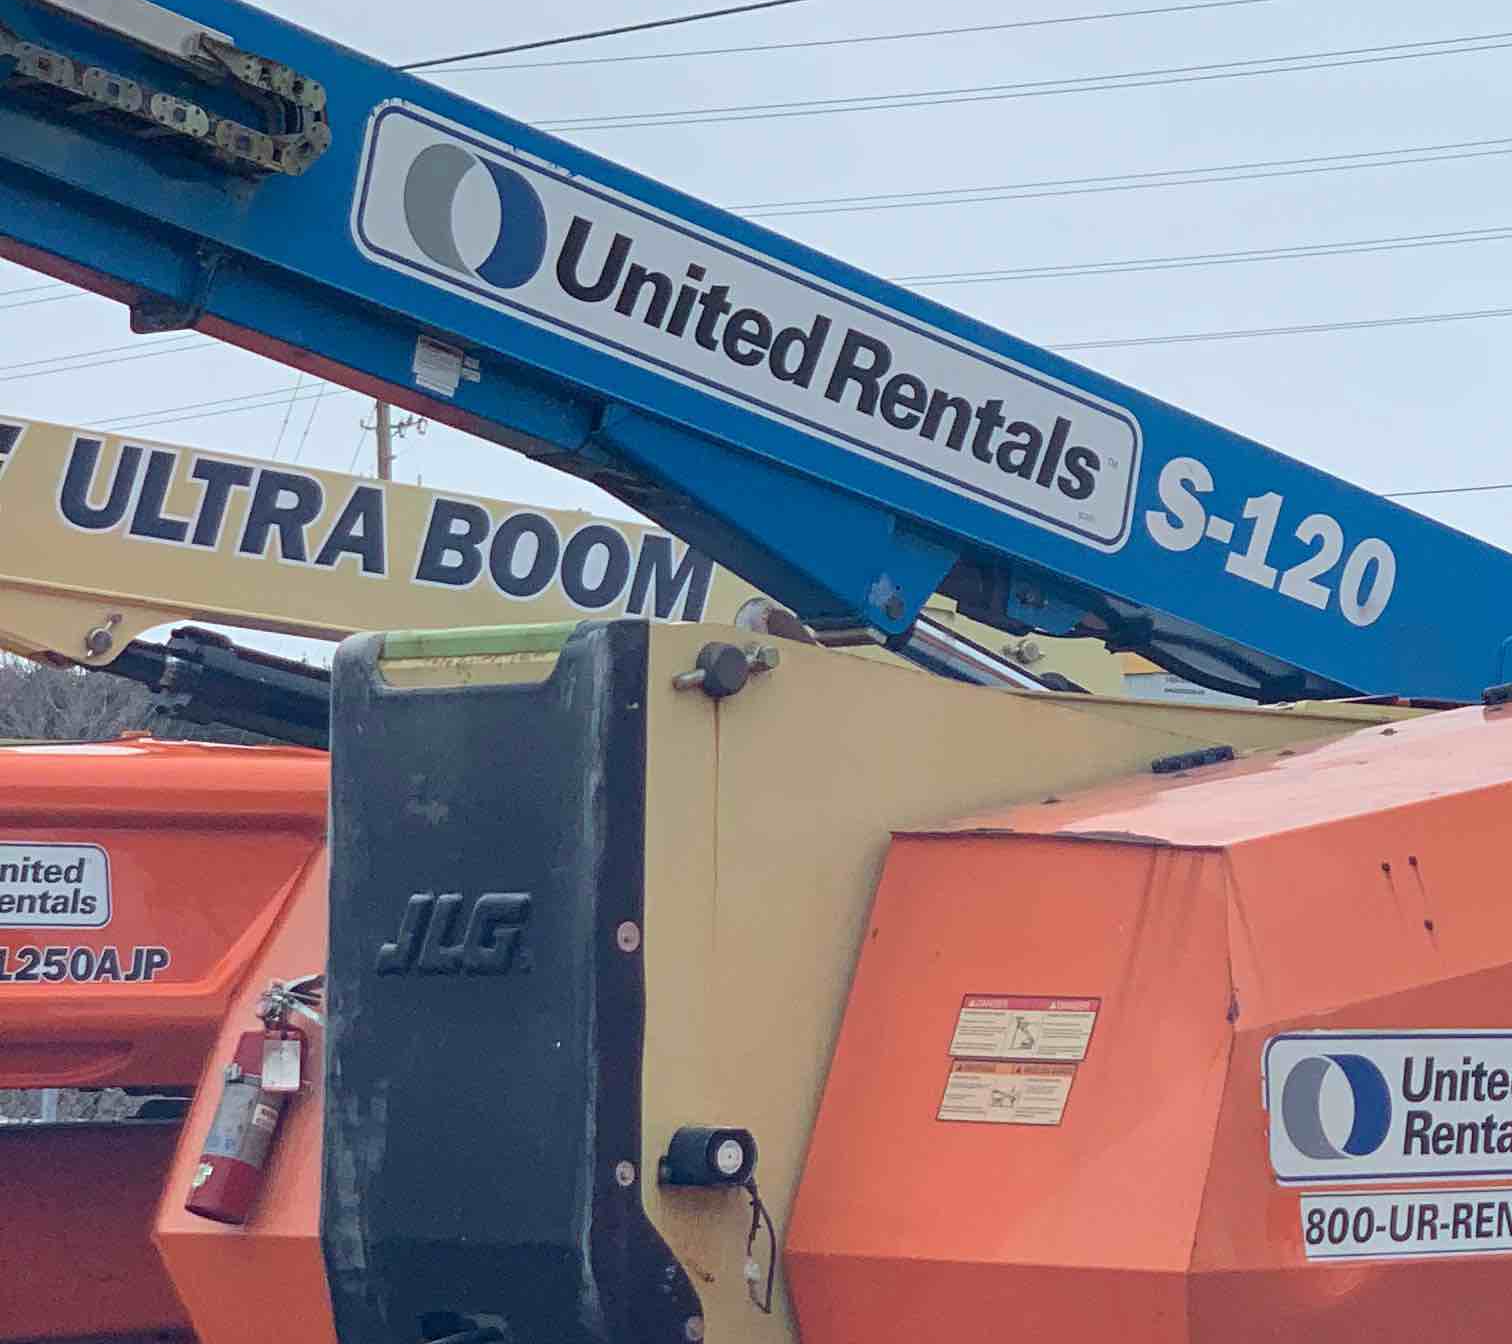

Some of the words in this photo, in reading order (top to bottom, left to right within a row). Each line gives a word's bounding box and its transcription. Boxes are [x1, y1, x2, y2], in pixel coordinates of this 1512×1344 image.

[555, 215, 833, 389] United
[823, 328, 1103, 501] Rentals
[58, 436, 386, 575] ULTRA
[414, 497, 713, 622] BOOM
[1144, 456, 1397, 627] S-120
[376, 892, 532, 976] JLG
